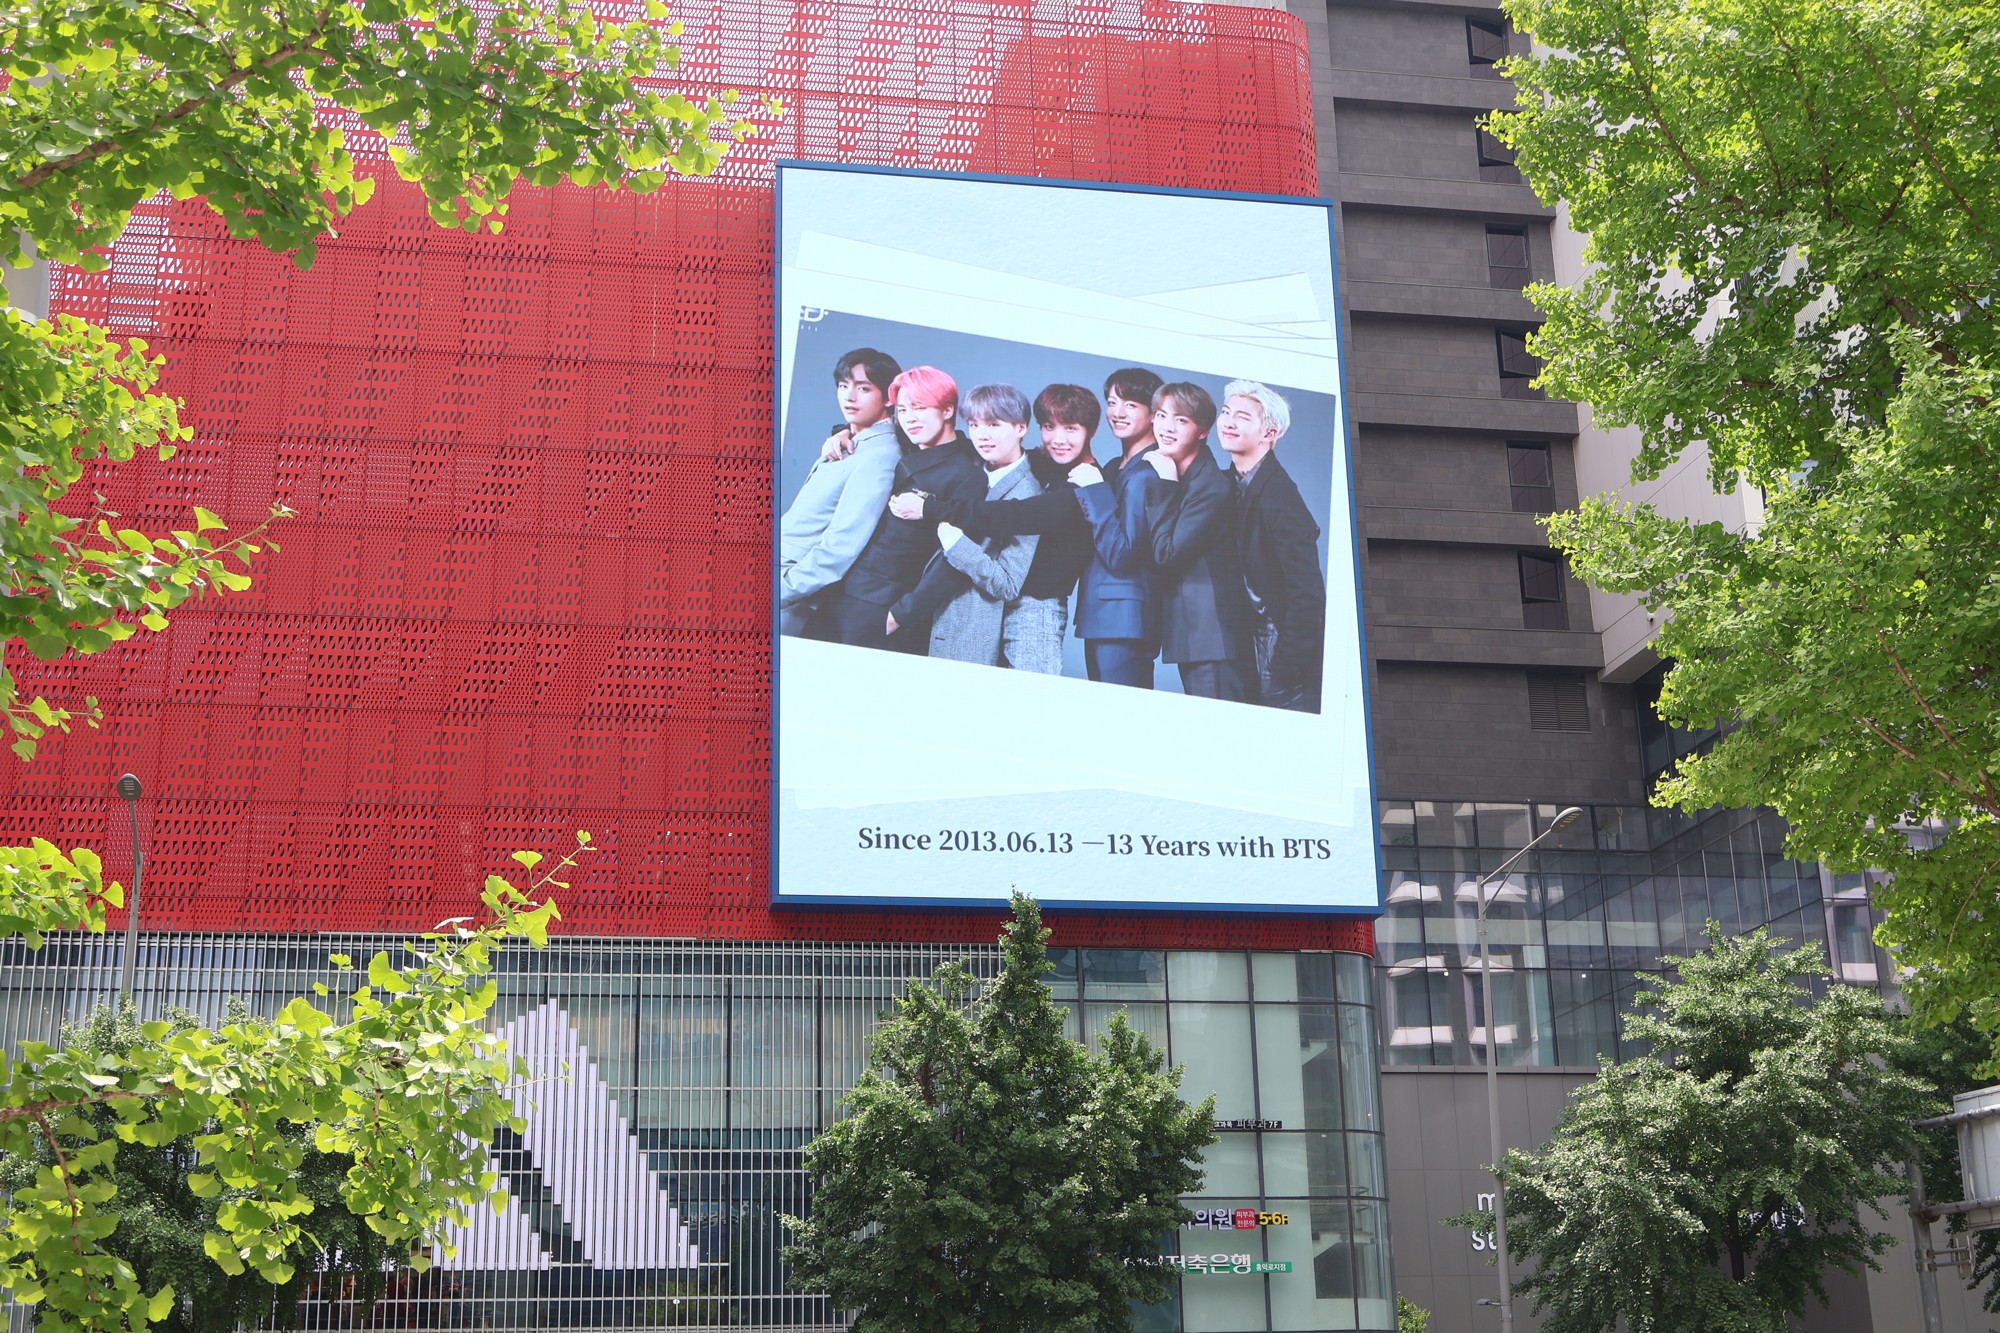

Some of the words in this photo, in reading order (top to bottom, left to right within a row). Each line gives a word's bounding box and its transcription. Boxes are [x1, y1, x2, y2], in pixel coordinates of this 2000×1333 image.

[858, 826, 932, 851] Since
[939, 829, 1073, 854] 2013.06.13
[1140, 834, 1211, 857] Years
[1216, 835, 1275, 858] with
[1282, 838, 1331, 860] BTS
[1123, 1253, 1252, 1275] 저축은행
